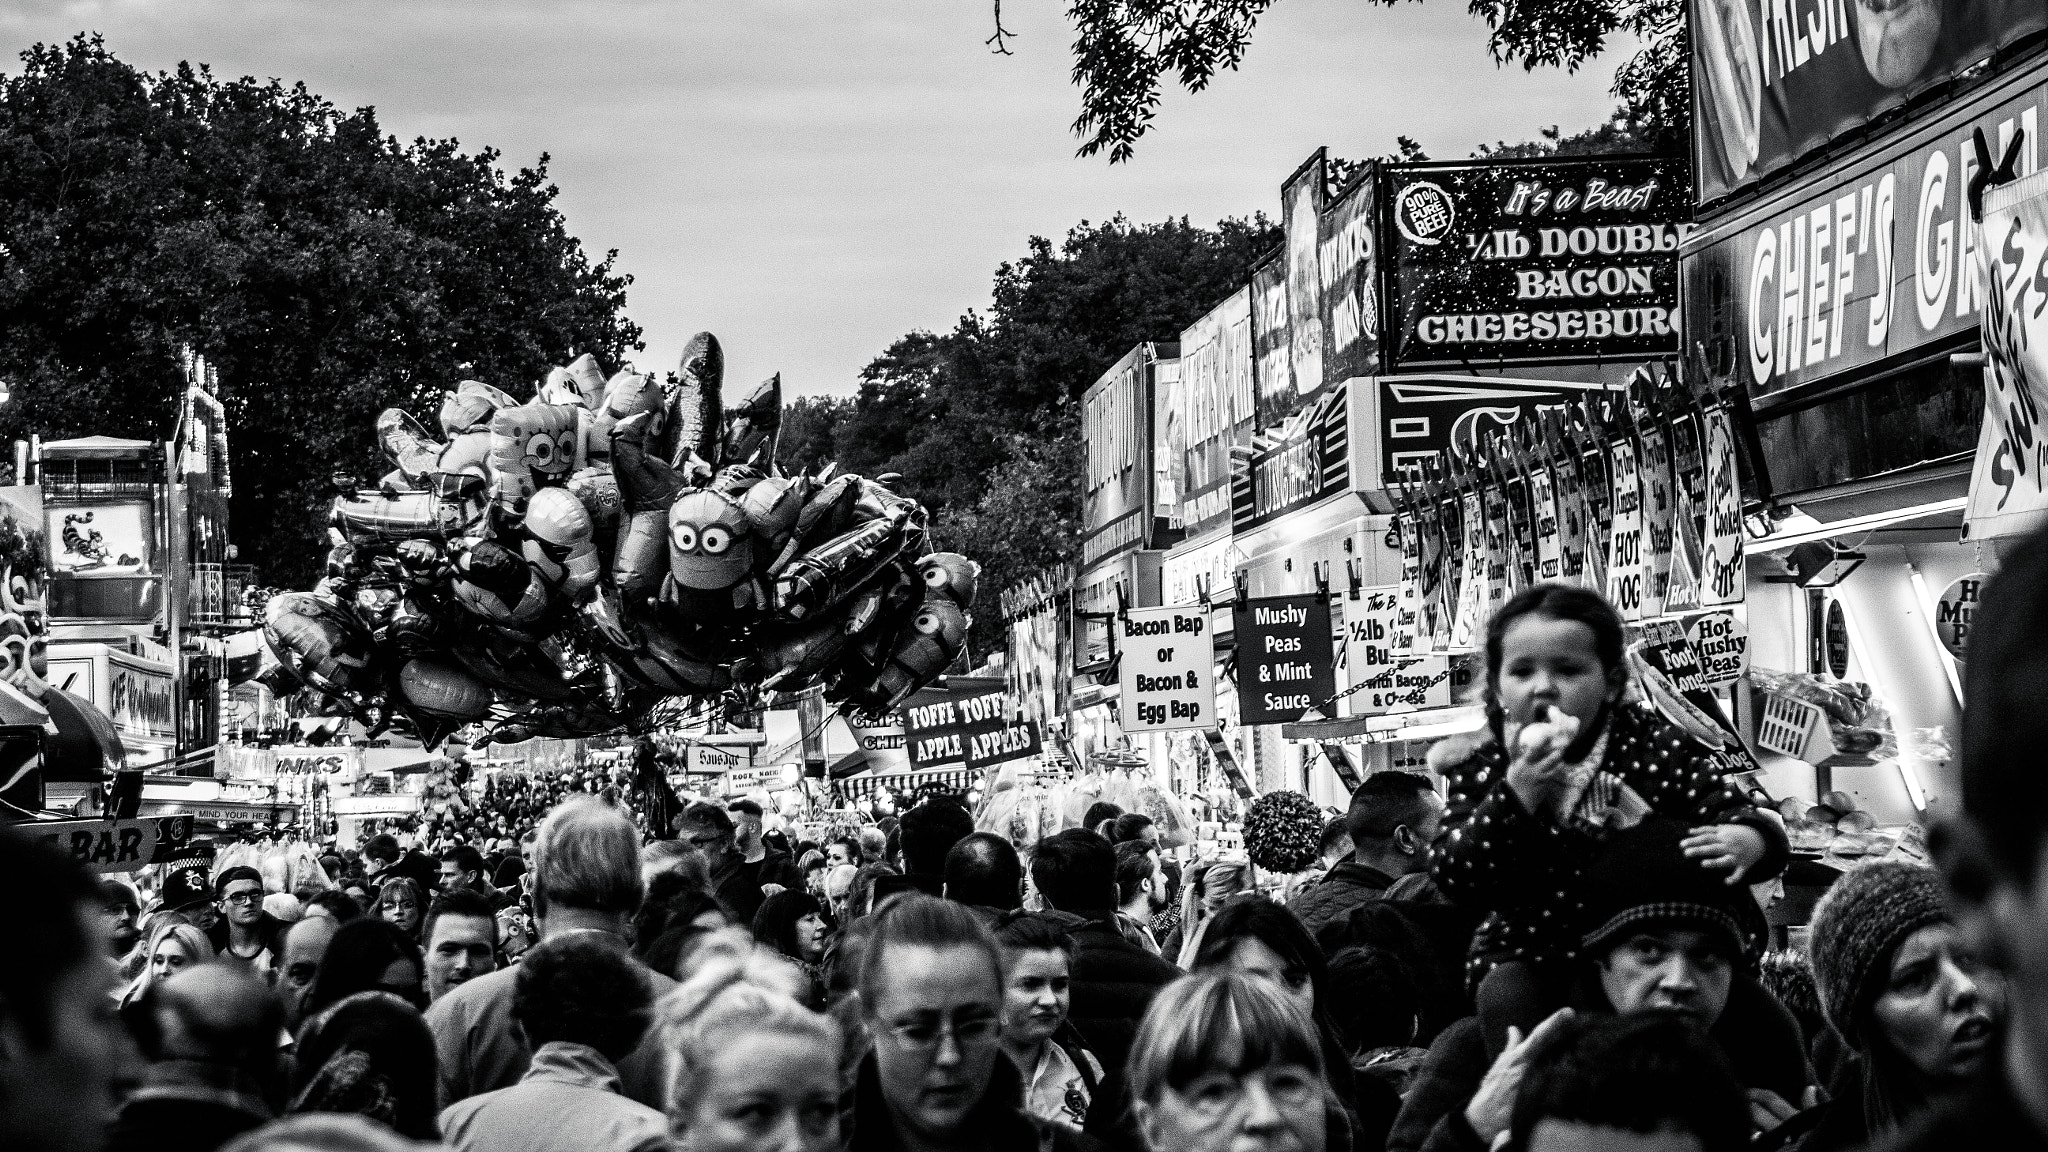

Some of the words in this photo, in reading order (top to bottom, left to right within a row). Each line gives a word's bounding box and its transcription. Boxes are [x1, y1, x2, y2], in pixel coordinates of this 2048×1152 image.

[1404, 187, 1439, 212] 90%
[1504, 180, 1550, 216] It's
[1554, 189, 1578, 213] a
[1581, 176, 1660, 212] Beast
[1410, 202, 1444, 223] PURE
[1413, 214, 1449, 237] BEEF
[1516, 266, 1654, 300] BACON
[1748, 173, 1896, 386] CHEF'S
[1417, 305, 1680, 344] CHEESEBUR
[1714, 501, 1741, 538] Cooked
[1613, 529, 1641, 568] HOT
[1705, 535, 1743, 598] CHIPS
[1367, 593, 1386, 612] The
[1611, 574, 1641, 611] DOG
[1125, 619, 1170, 637] Bacon
[1173, 614, 1204, 637] Bap
[1255, 603, 1307, 627] Mushy
[1698, 618, 1734, 640] Hot
[1157, 645, 1174, 663] or
[1265, 634, 1302, 653] Peas
[1660, 647, 1696, 671] Foot
[1701, 655, 1742, 675] Peas
[1136, 674, 1182, 693] Bacon
[1185, 670, 1199, 689] &
[1258, 665, 1272, 683] &
[1275, 662, 1313, 681] Mint
[1396, 674, 1431, 689] Bacon
[1137, 702, 1166, 724] Egg
[1171, 699, 1200, 721] Bap
[1264, 692, 1311, 711] Sauce
[1373, 694, 1383, 707] &
[908, 701, 956, 730] TOFFE
[916, 734, 963, 763] APPLE
[199, 810, 221, 818] MIND
[225, 811, 248, 819] YOUR
[252, 811, 272, 820] HEA
[70, 827, 144, 865] BAR
